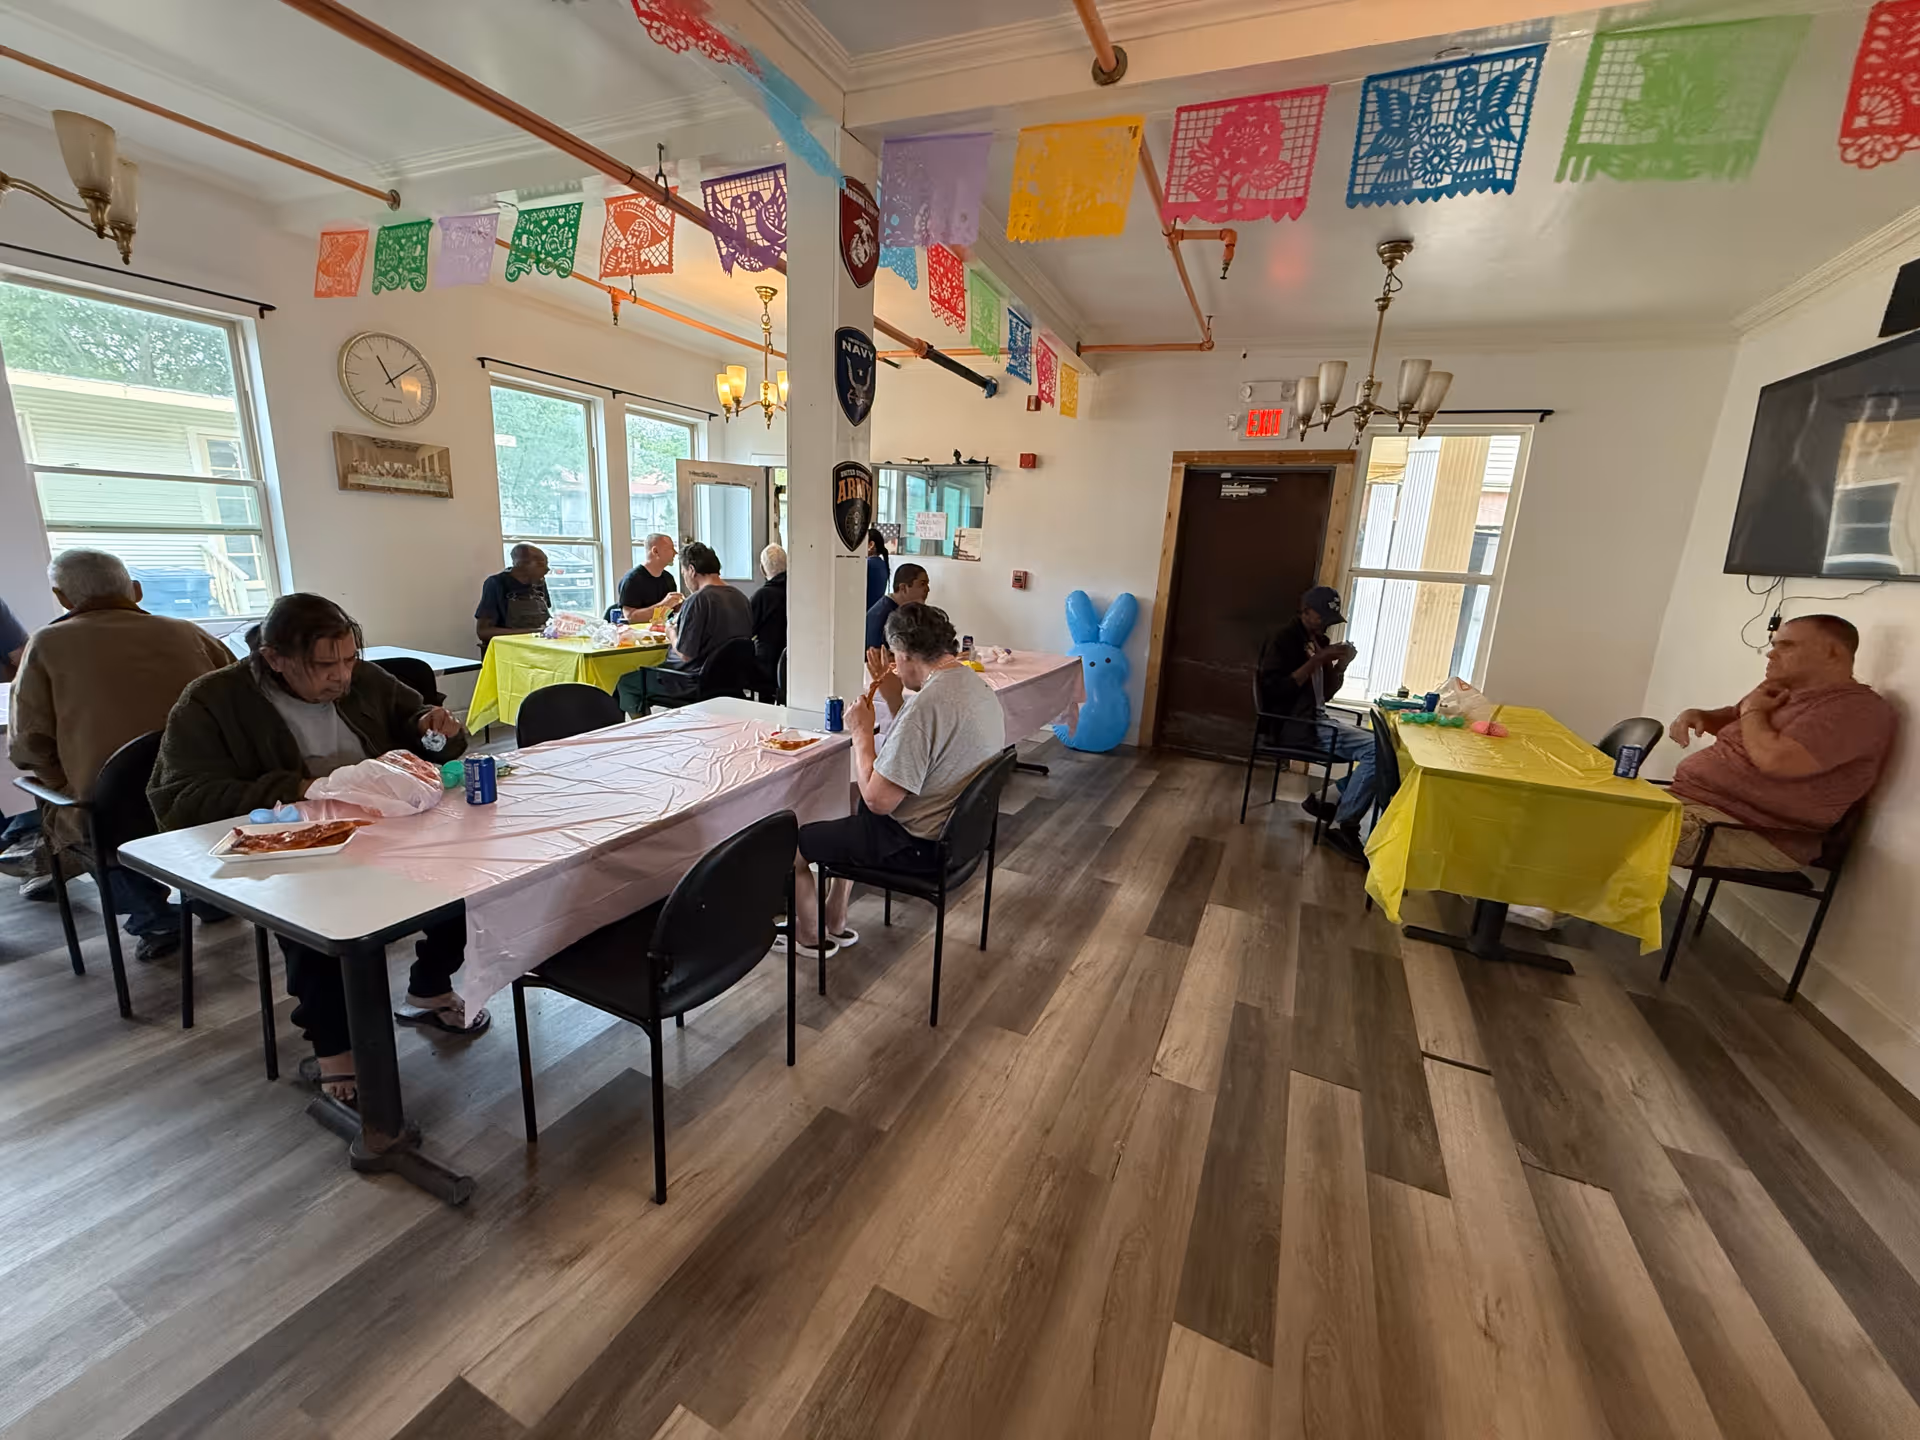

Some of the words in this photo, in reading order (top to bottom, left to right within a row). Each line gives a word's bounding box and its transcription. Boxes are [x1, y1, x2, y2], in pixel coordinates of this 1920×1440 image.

[841, 339, 874, 361] NAVY
[1246, 408, 1284, 437] EXIT
[837, 477, 872, 505] ARMY
